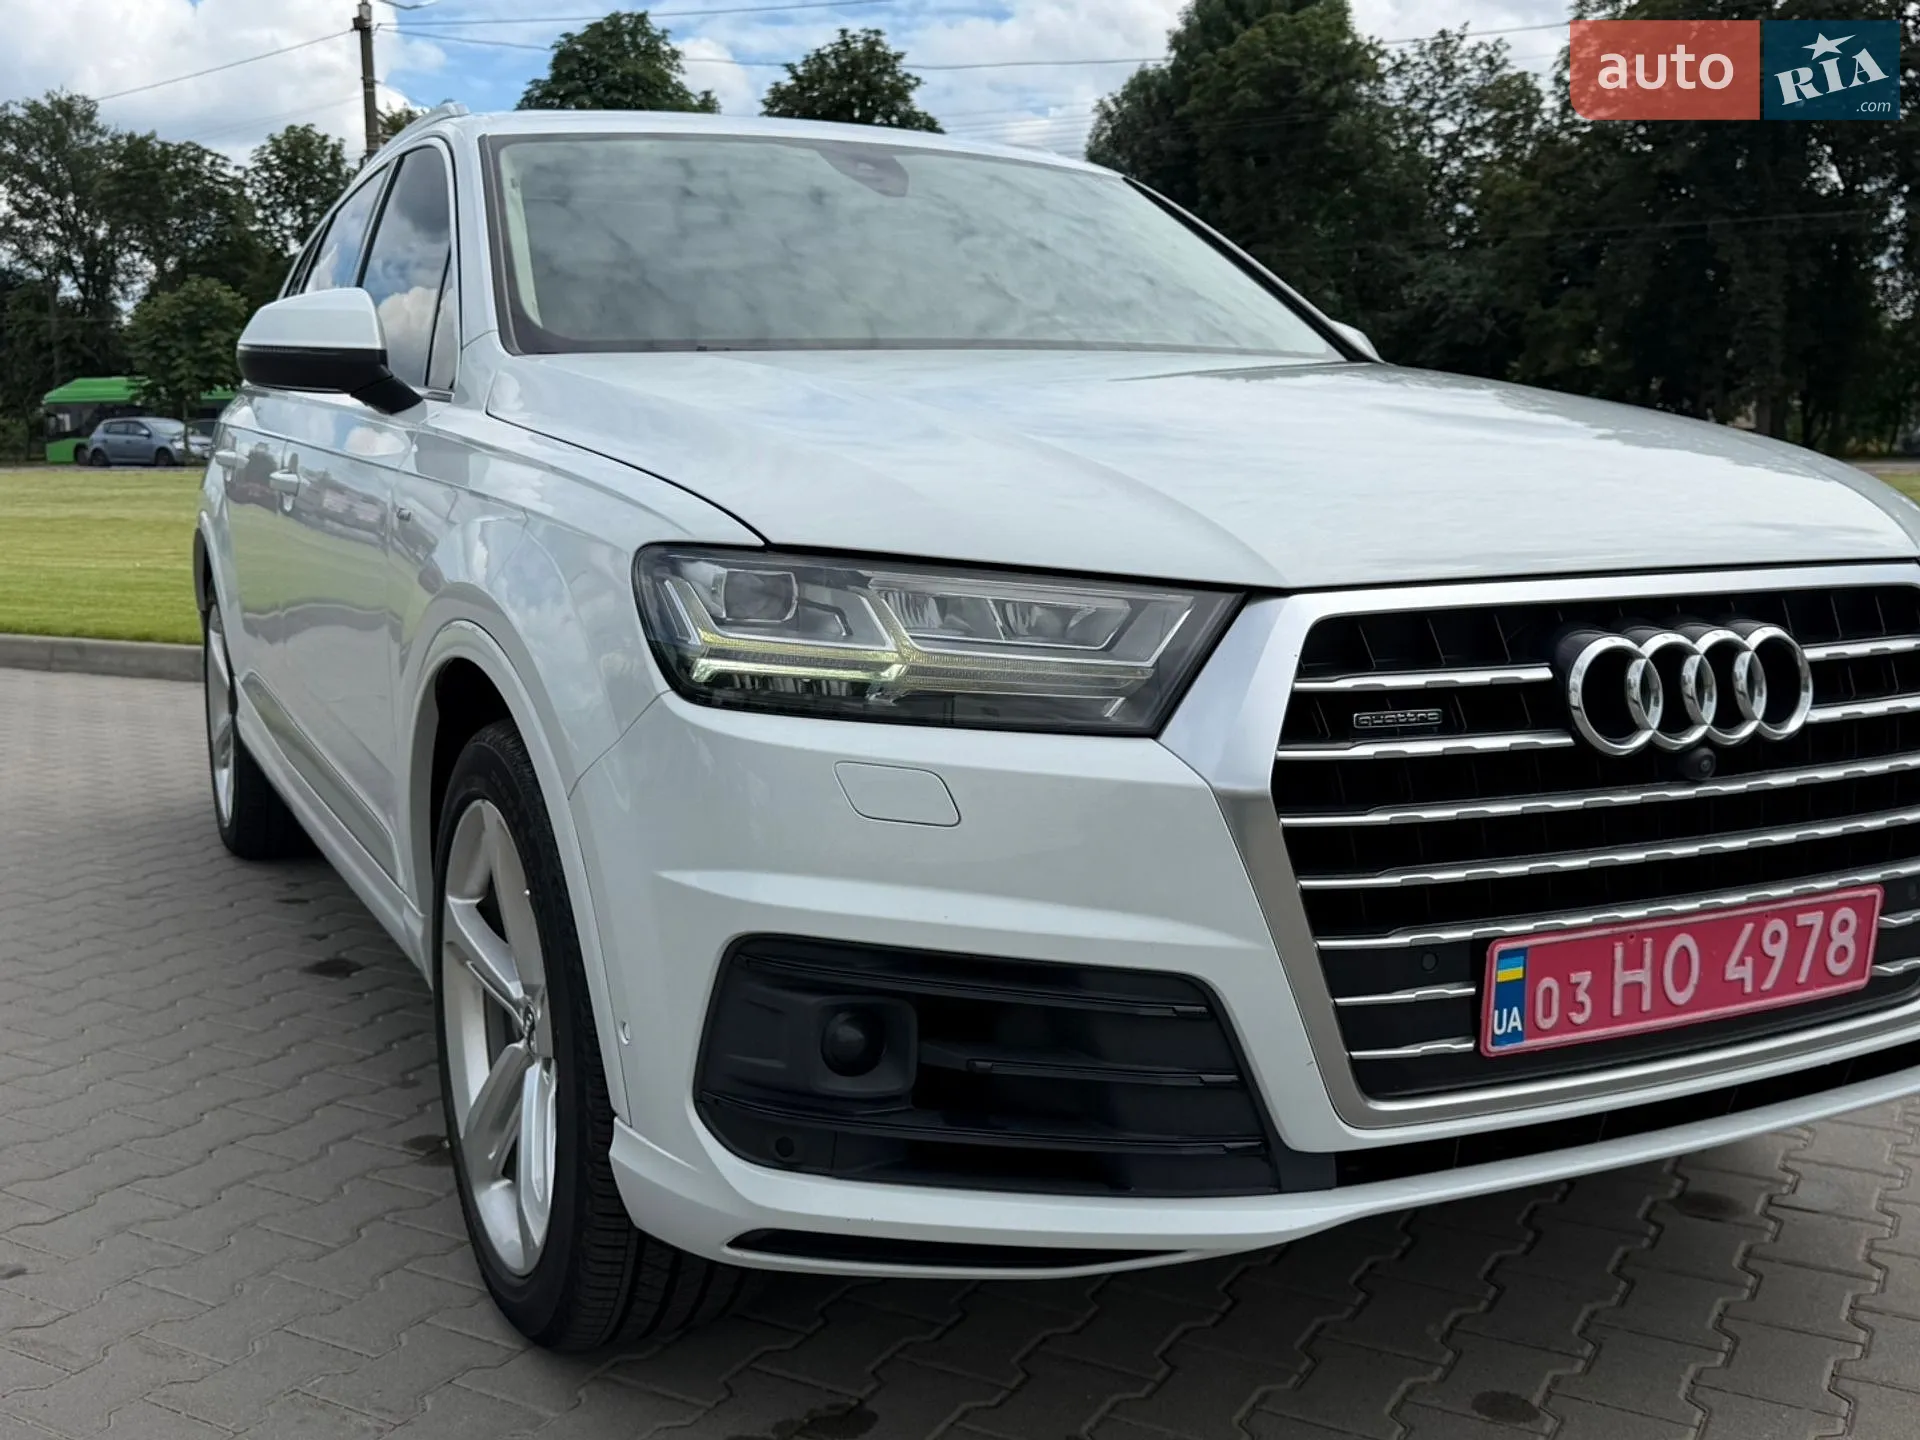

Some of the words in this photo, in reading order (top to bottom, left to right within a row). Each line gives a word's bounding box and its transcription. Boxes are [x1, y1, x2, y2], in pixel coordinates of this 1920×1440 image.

[1358, 711, 1440, 726] quattro
[1534, 971, 1593, 1031] 03
[1611, 933, 1700, 1017] HO
[1724, 907, 1859, 994] 4978
[1492, 1007, 1523, 1036] UA
